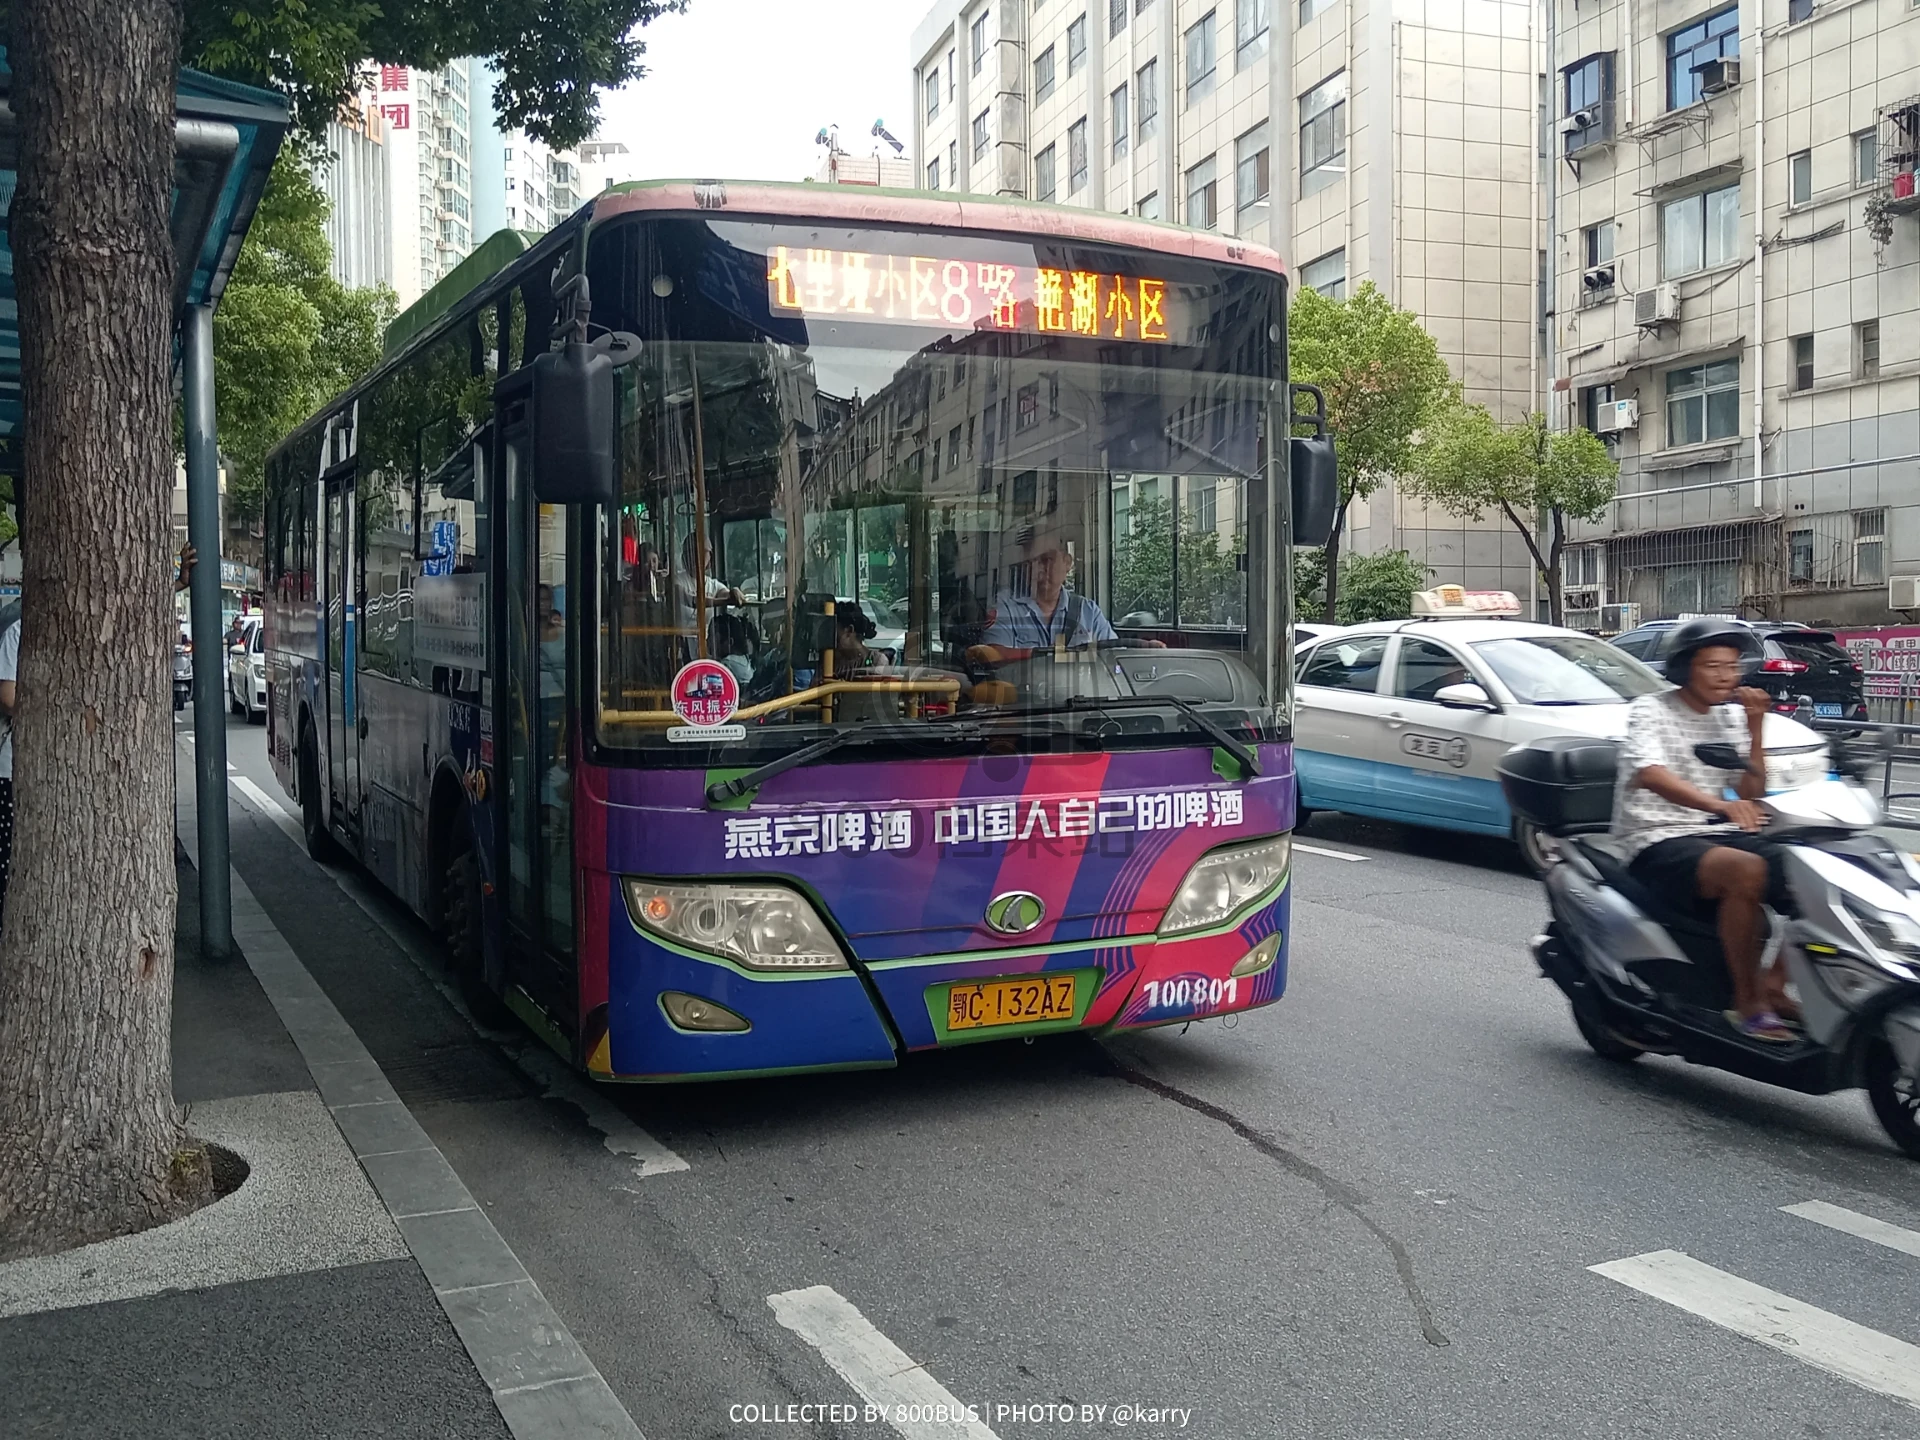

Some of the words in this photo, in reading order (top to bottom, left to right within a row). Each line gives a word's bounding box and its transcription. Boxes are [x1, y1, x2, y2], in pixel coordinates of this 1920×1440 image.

[381, 66, 409, 128] 集团
[675, 700, 737, 715] 东风振兴
[724, 810, 912, 859] 燕京啤酒
[934, 791, 1243, 844] 中国人自己的啤酒
[1143, 977, 1238, 1008] 100801
